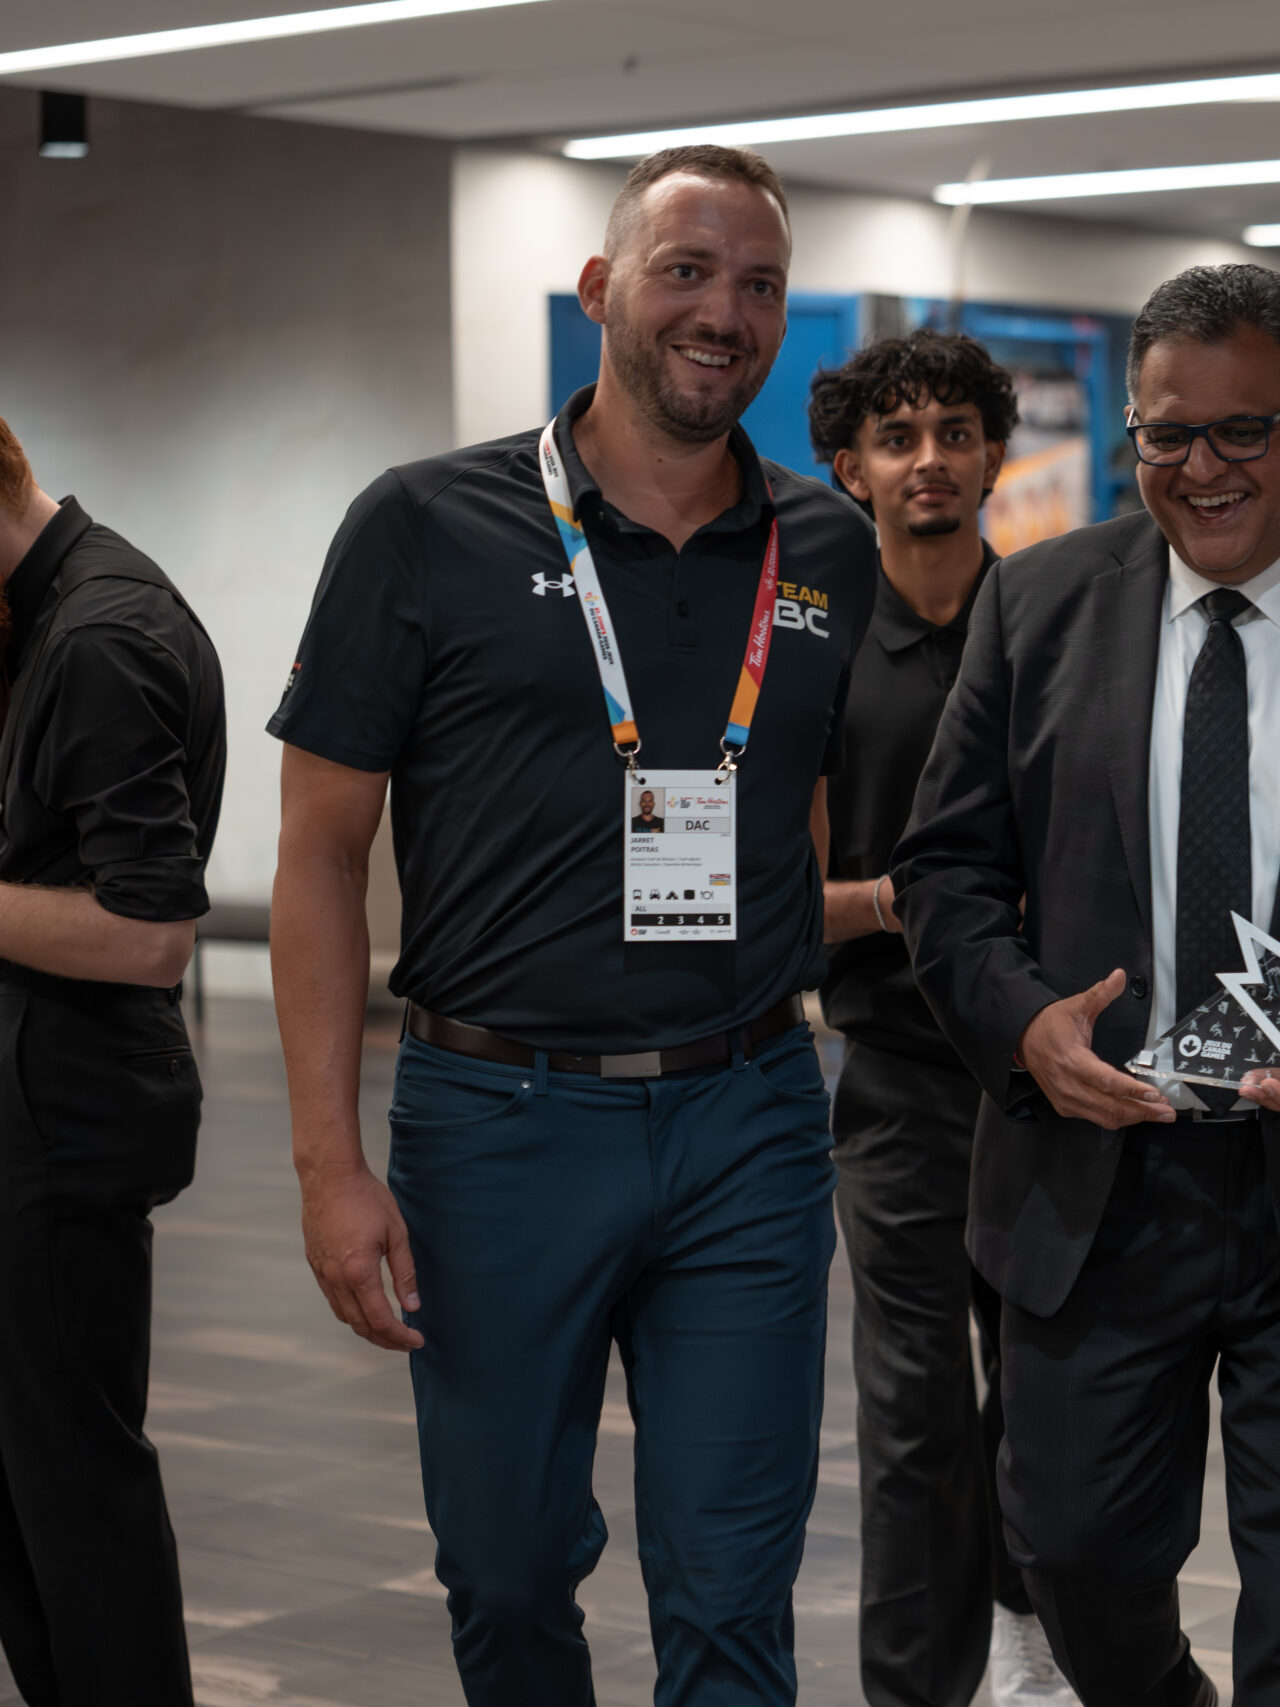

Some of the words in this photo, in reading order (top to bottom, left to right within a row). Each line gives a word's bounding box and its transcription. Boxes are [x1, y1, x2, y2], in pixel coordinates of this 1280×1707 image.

[772, 598, 830, 639] BC
[754, 610, 771, 649] Hortons
[749, 649, 763, 667] Tim
[685, 820, 711, 831] DAC
[657, 915, 665, 925] 2
[677, 915, 685, 925] 3
[697, 915, 704, 924] 4
[717, 915, 724, 924] 5
[1200, 1051, 1226, 1060] GAMES
[1202, 1045, 1231, 1055] CANADA
